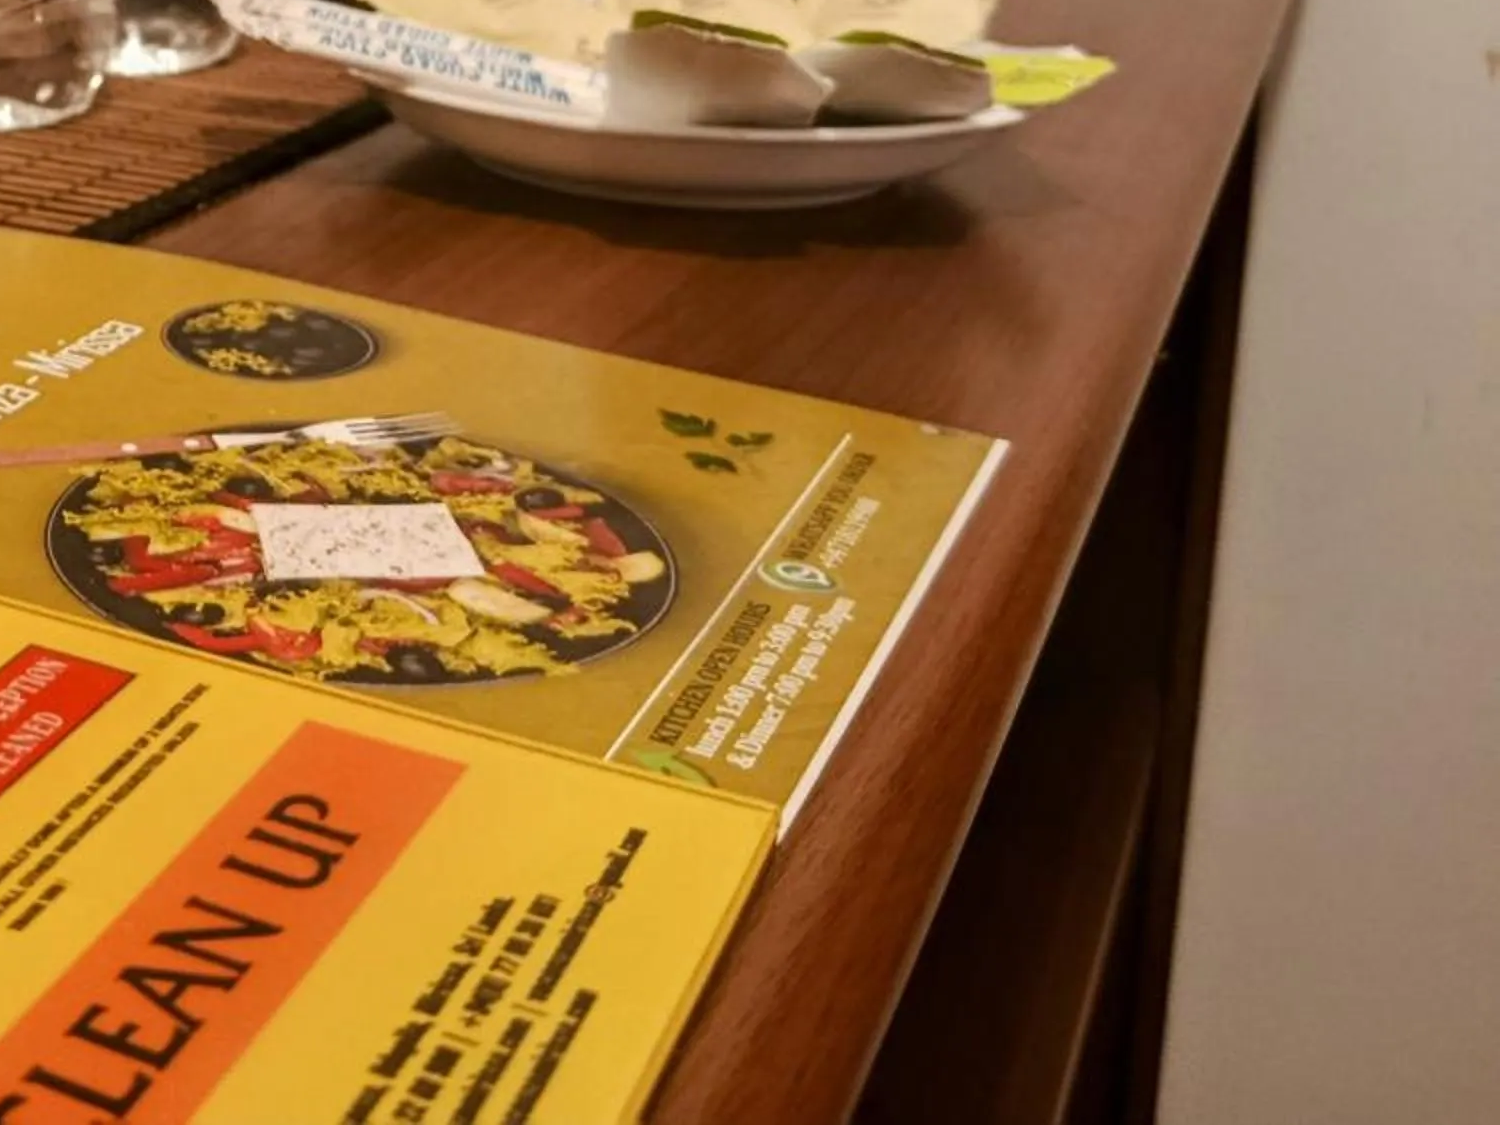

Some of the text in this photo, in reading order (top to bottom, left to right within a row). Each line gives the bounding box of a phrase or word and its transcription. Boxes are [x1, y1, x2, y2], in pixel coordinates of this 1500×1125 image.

[13, 319, 145, 378] Mirissa
[649, 600, 771, 747] KITCHEN OPEN HOURS
[733, 704, 787, 754] Dinner
[726, 751, 756, 770] &
[220, 792, 361, 891] UP
